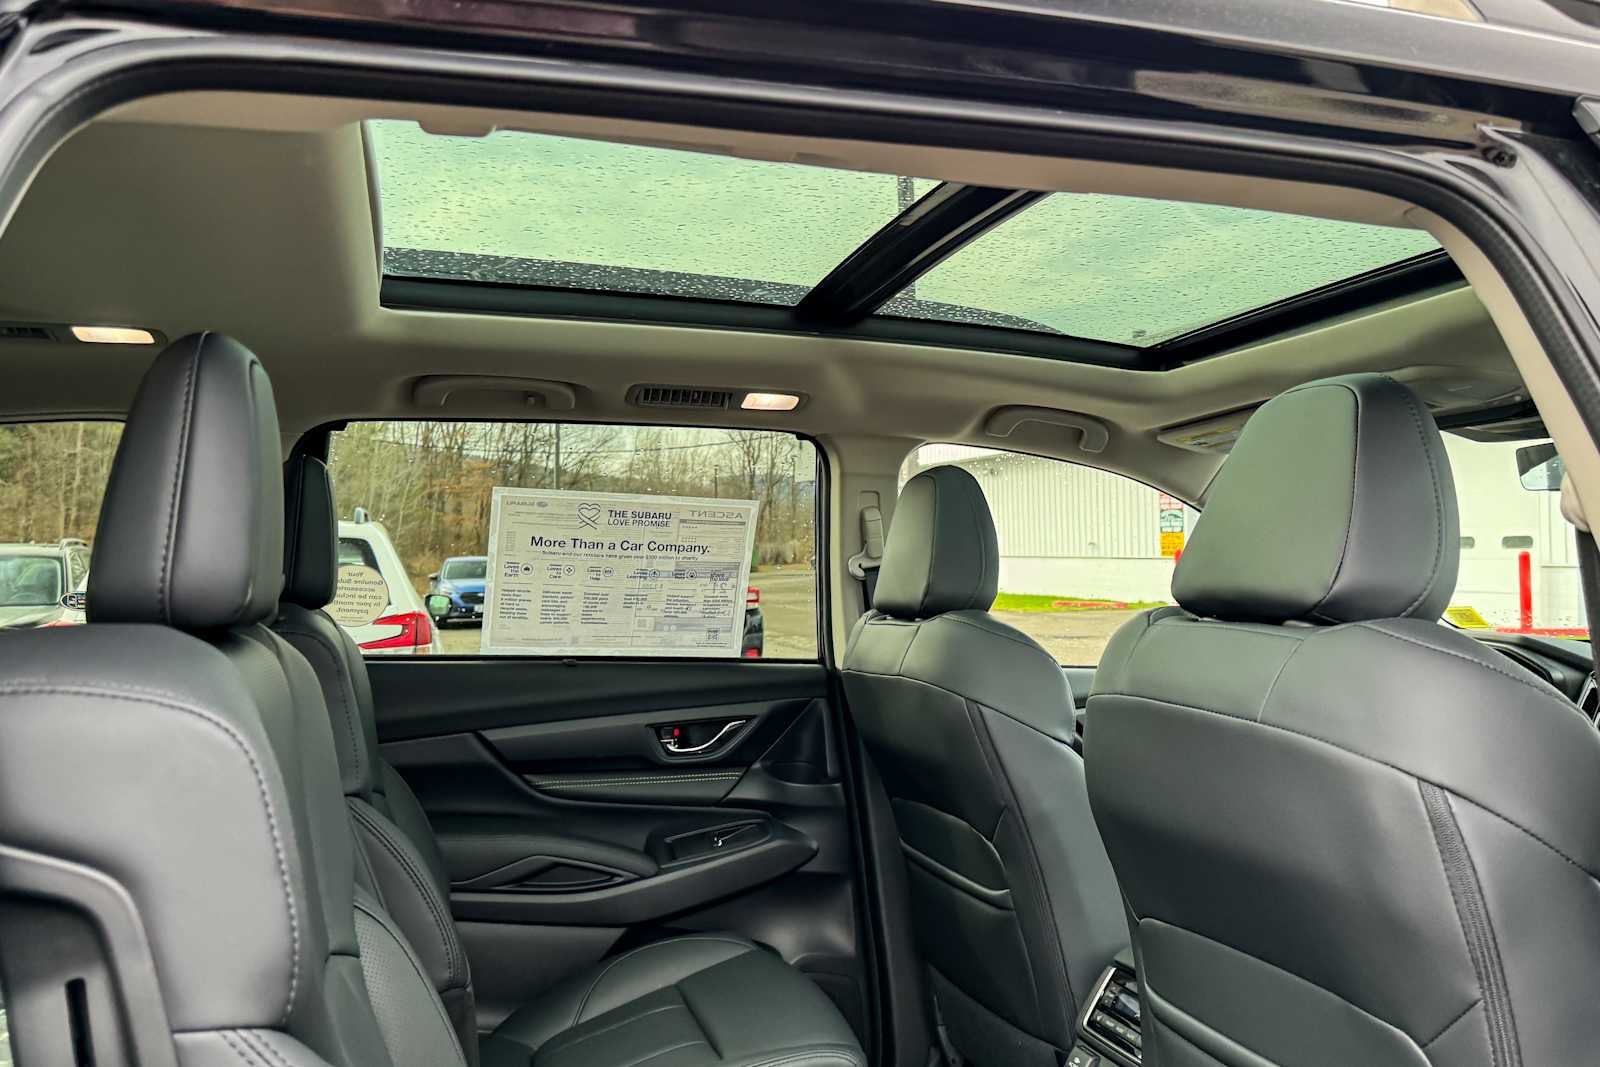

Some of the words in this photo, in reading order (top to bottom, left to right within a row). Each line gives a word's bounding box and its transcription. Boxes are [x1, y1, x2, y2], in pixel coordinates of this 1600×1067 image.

[608, 509, 628, 518] THE
[631, 511, 672, 520] SUBARU
[607, 518, 630, 526] LOVE
[632, 519, 671, 528] PROMISE
[530, 536, 566, 548] More
[571, 537, 604, 550] Than
[607, 542, 616, 550] a
[620, 540, 644, 551] Car
[647, 541, 711, 555] Company.
